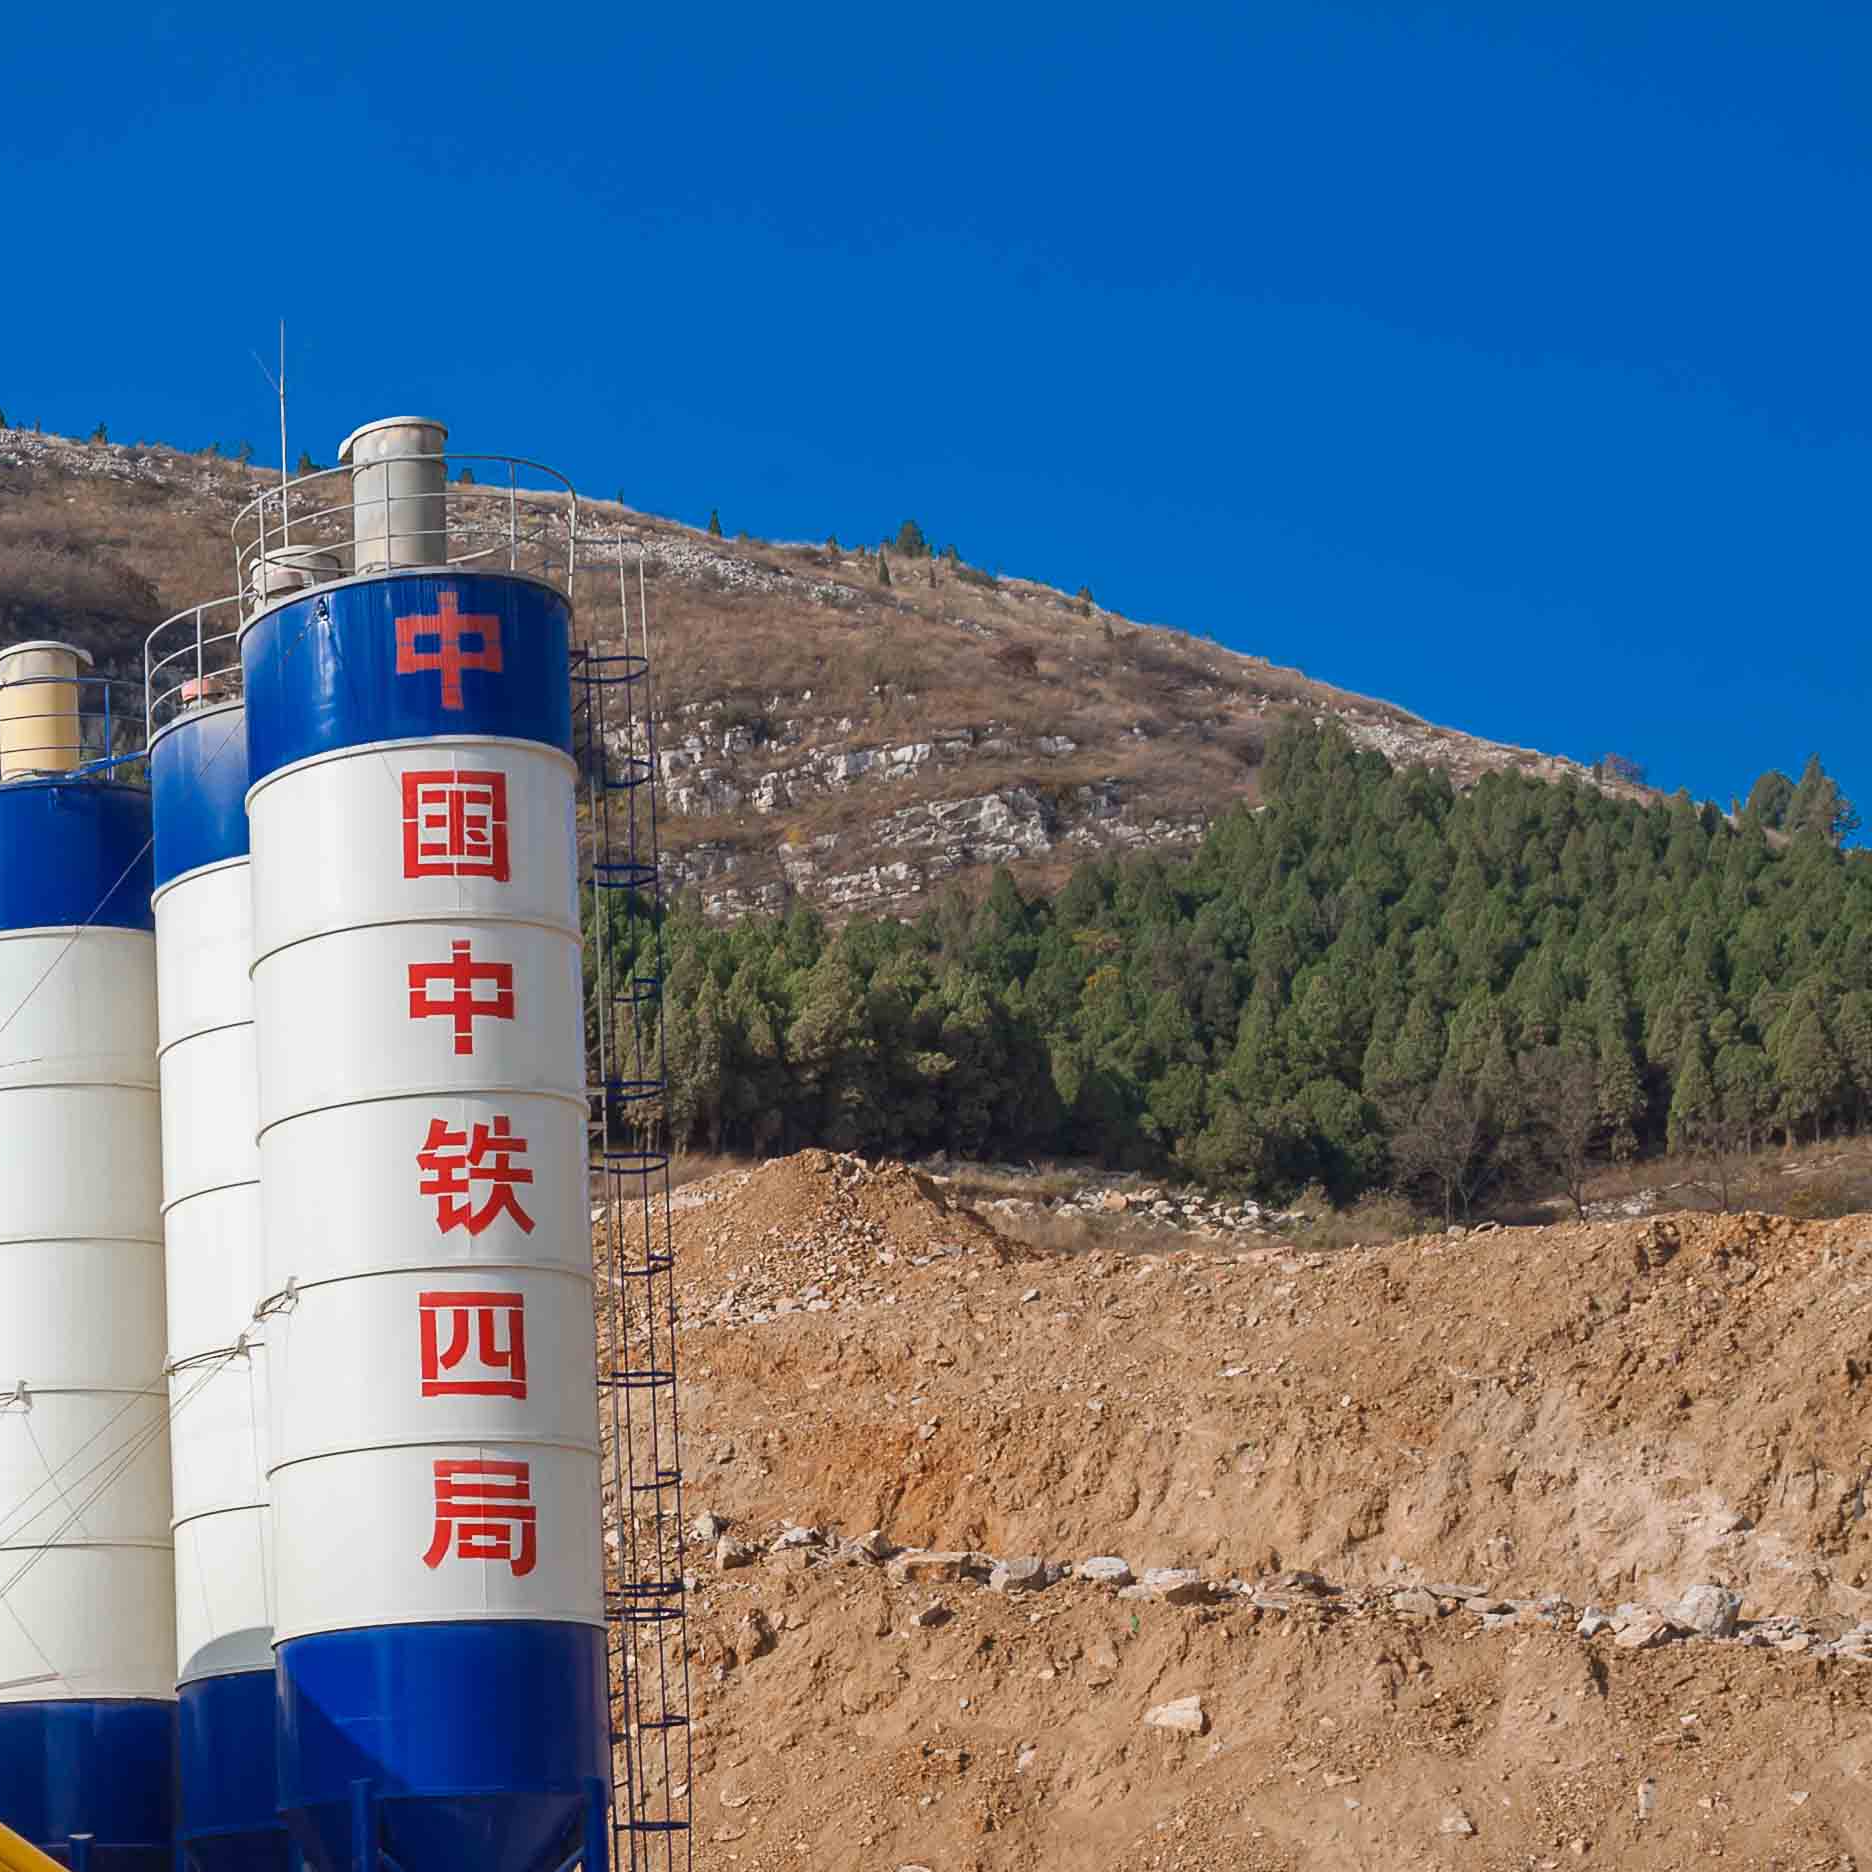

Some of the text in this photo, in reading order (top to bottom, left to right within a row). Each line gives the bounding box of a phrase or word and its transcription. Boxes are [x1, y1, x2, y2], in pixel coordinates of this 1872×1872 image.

[395, 591, 538, 1579] 中国中铁四局
